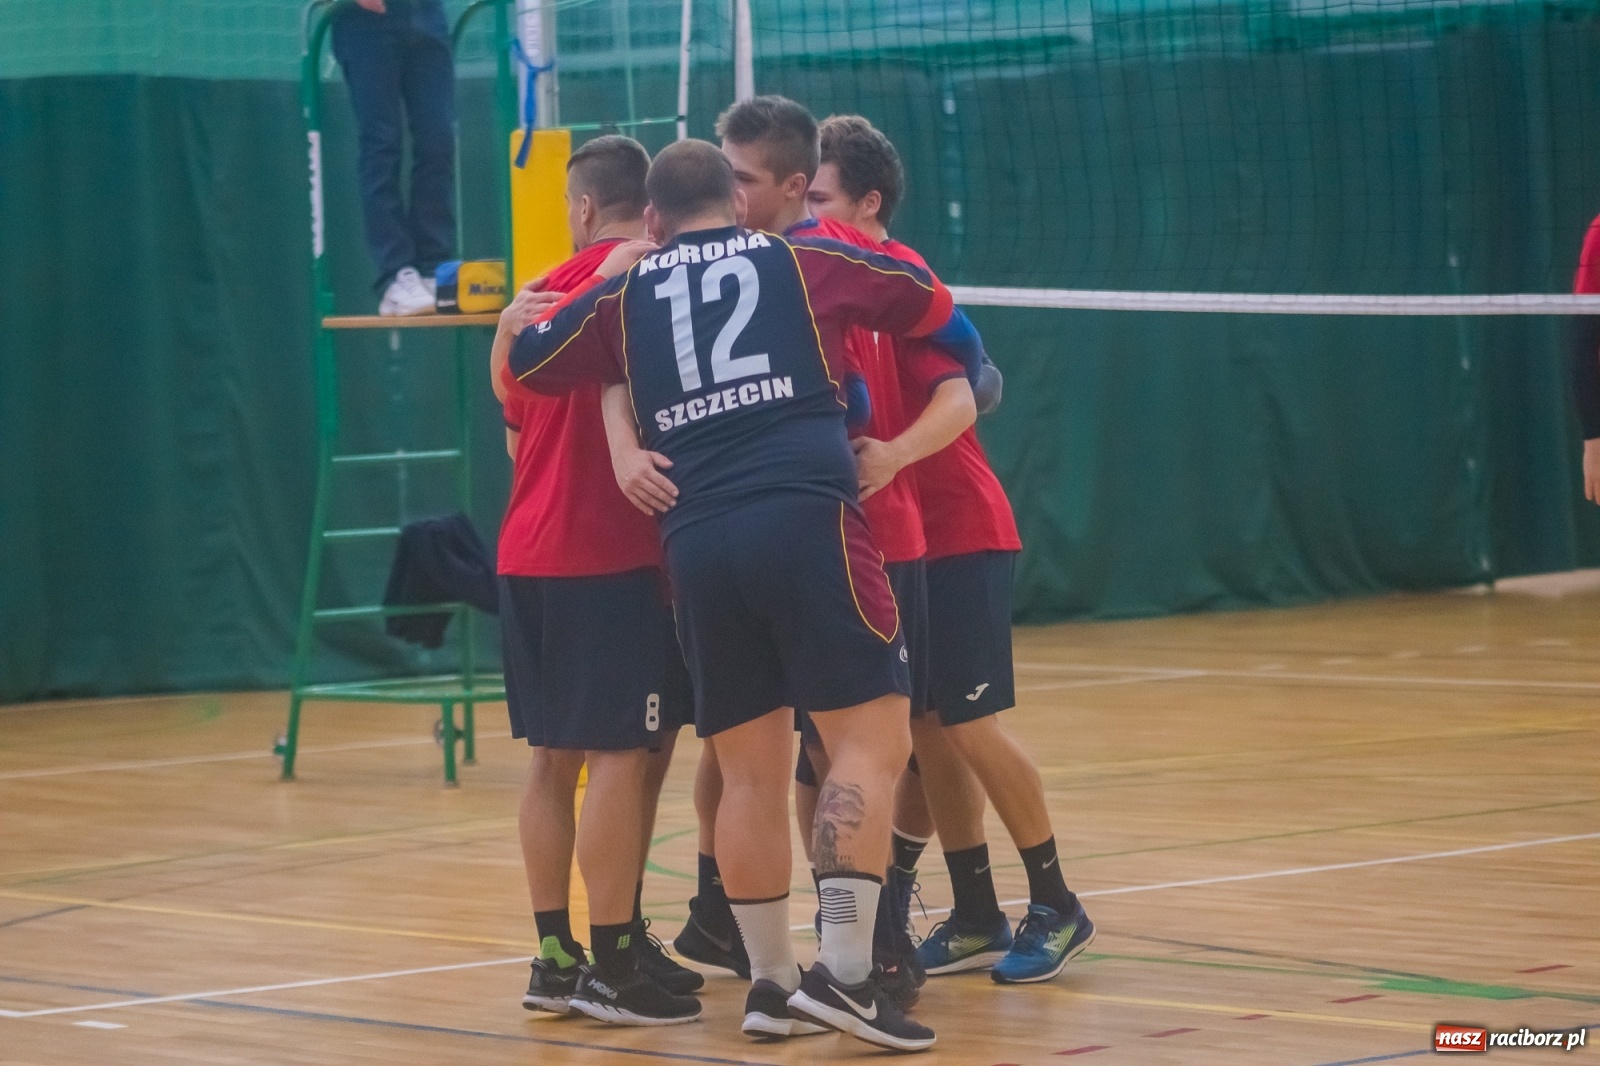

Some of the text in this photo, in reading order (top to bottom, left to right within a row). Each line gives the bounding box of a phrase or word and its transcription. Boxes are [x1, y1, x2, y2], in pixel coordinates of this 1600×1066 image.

[638, 232, 771, 277] KORONA
[654, 255, 771, 393] 12
[654, 376, 794, 432] SZCZECIN
[645, 693, 660, 732] 8
[588, 978, 618, 1000] HOKA
